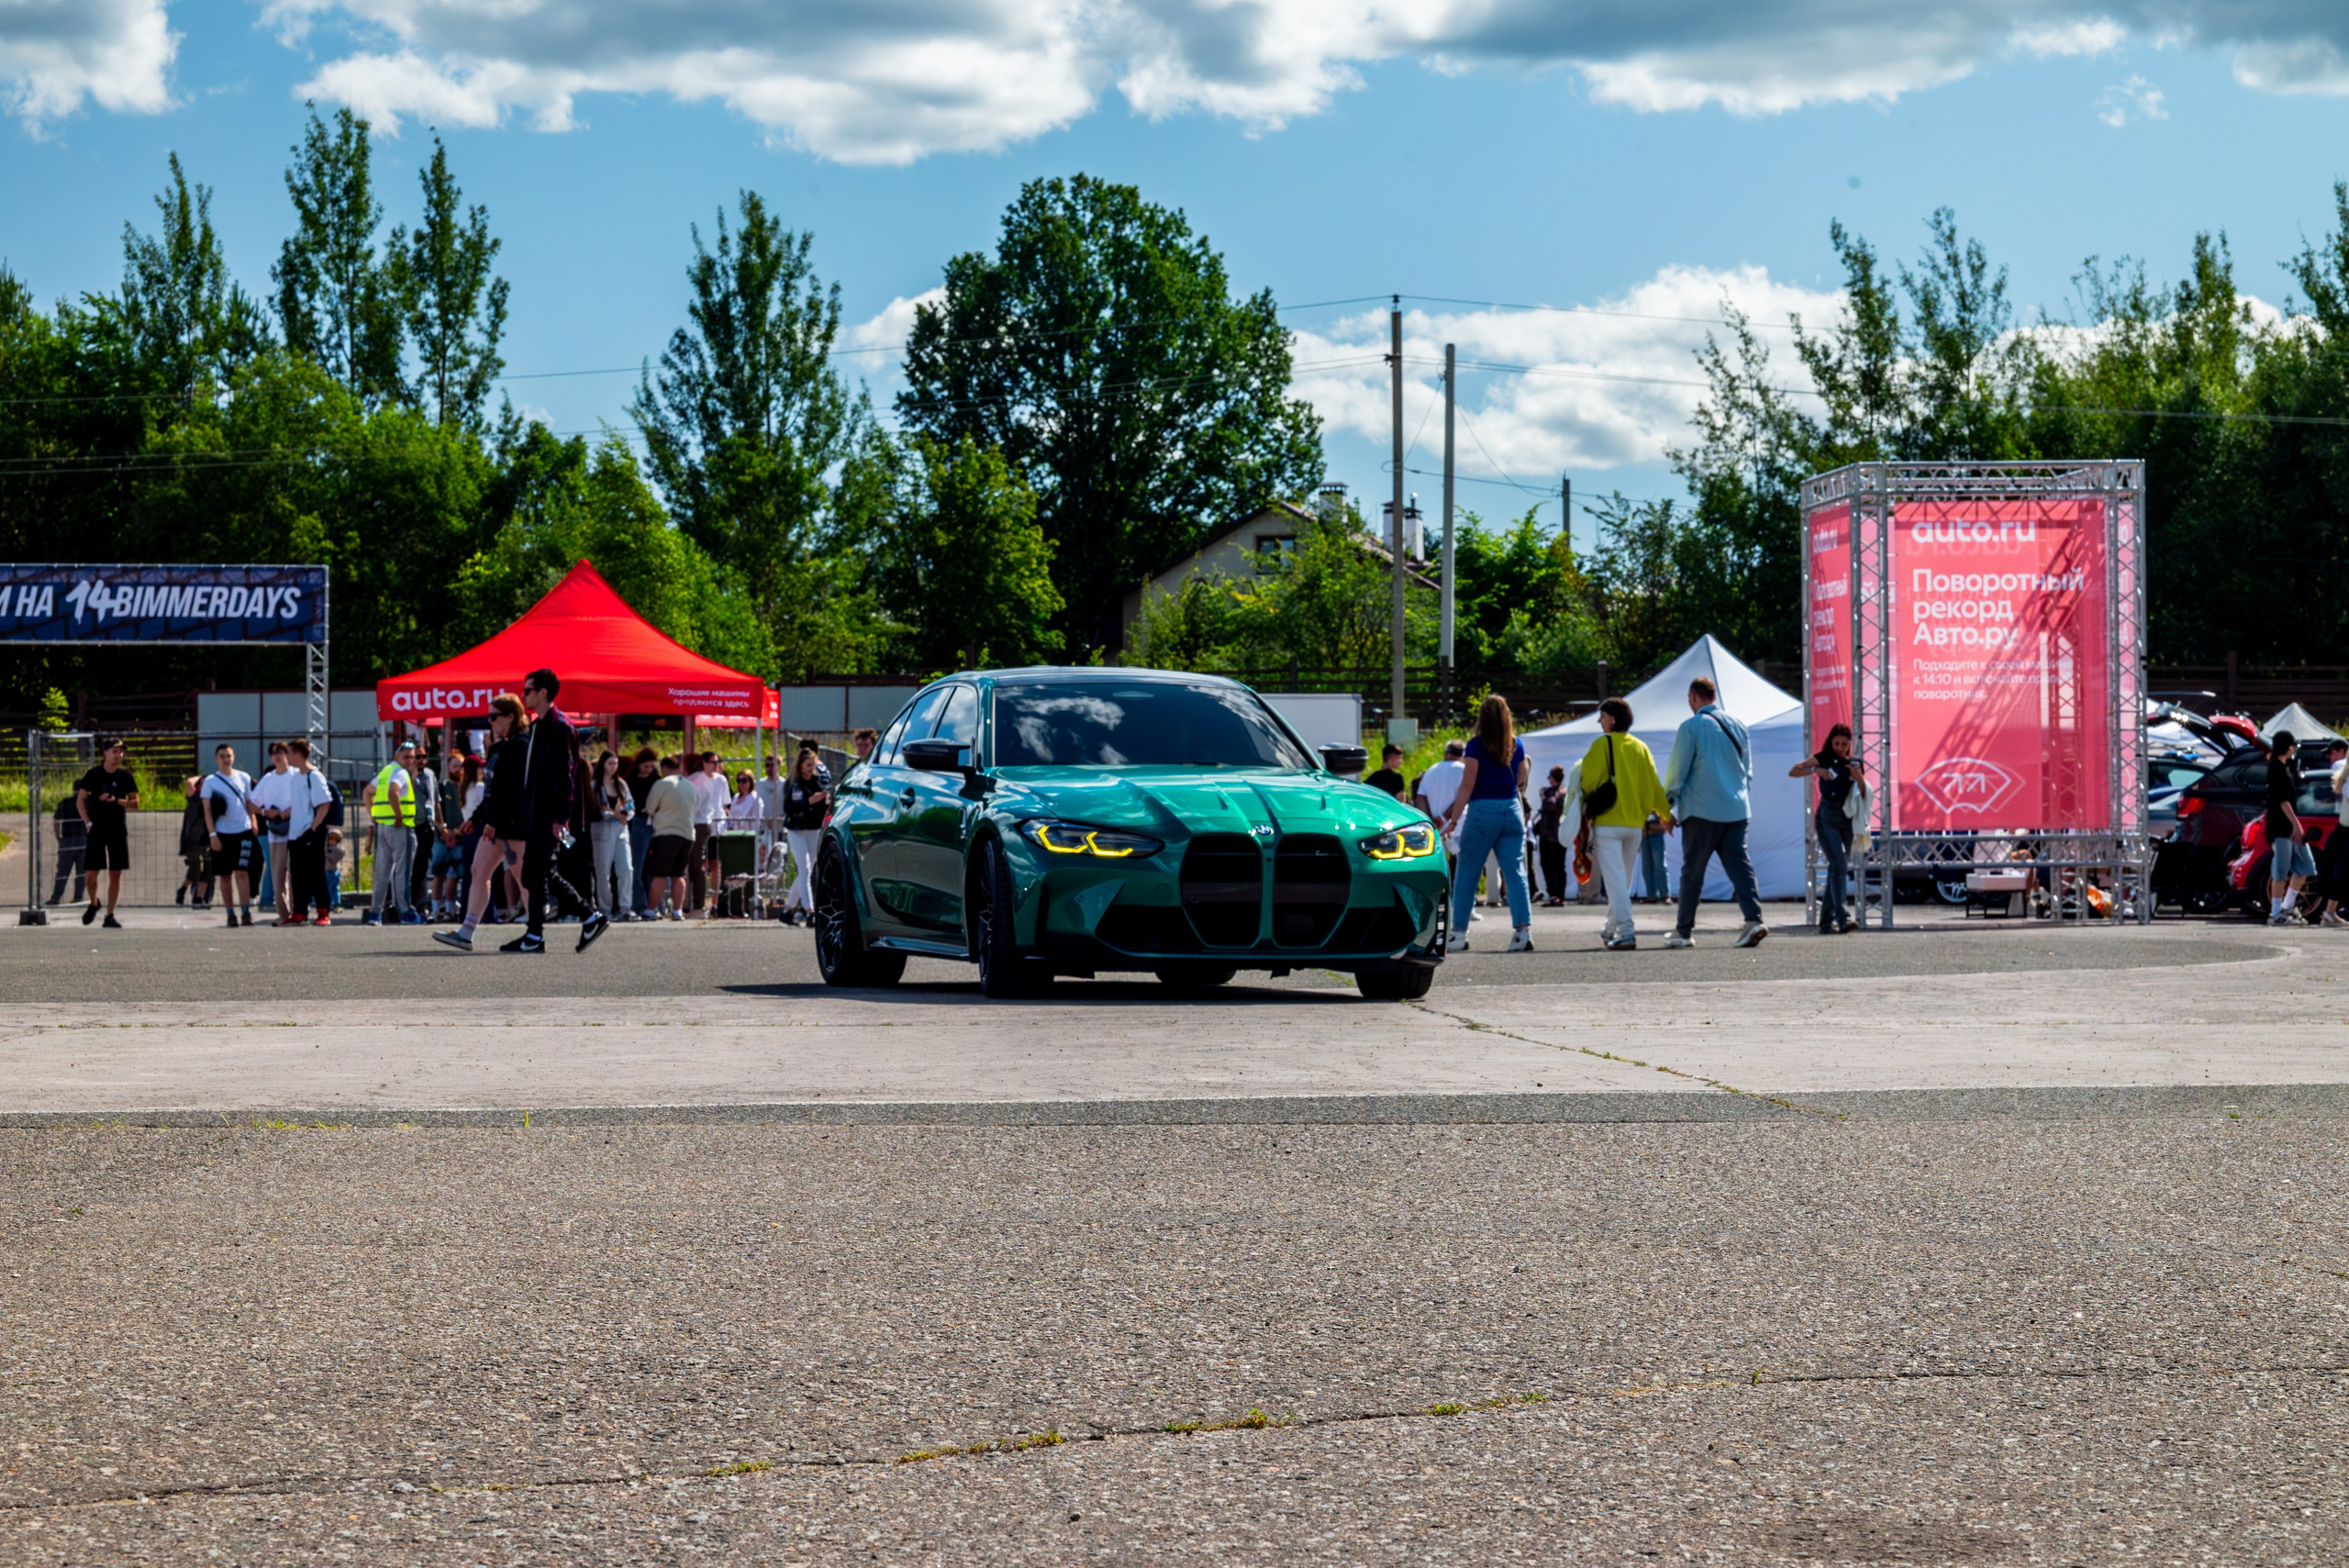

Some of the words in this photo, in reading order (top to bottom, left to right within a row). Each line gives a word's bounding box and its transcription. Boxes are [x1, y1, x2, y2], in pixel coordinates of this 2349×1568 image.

[1911, 517, 2035, 543] auto.ru
[1913, 567, 2084, 596] Поворотный
[15, 585, 53, 617] НА
[1913, 600, 2014, 624] рекорд
[1913, 622, 2019, 650] Авто.ру
[1913, 659, 1978, 672] Подходите
[1980, 661, 1987, 671] к
[1913, 675, 1920, 684] к
[1954, 675, 1961, 684] и
